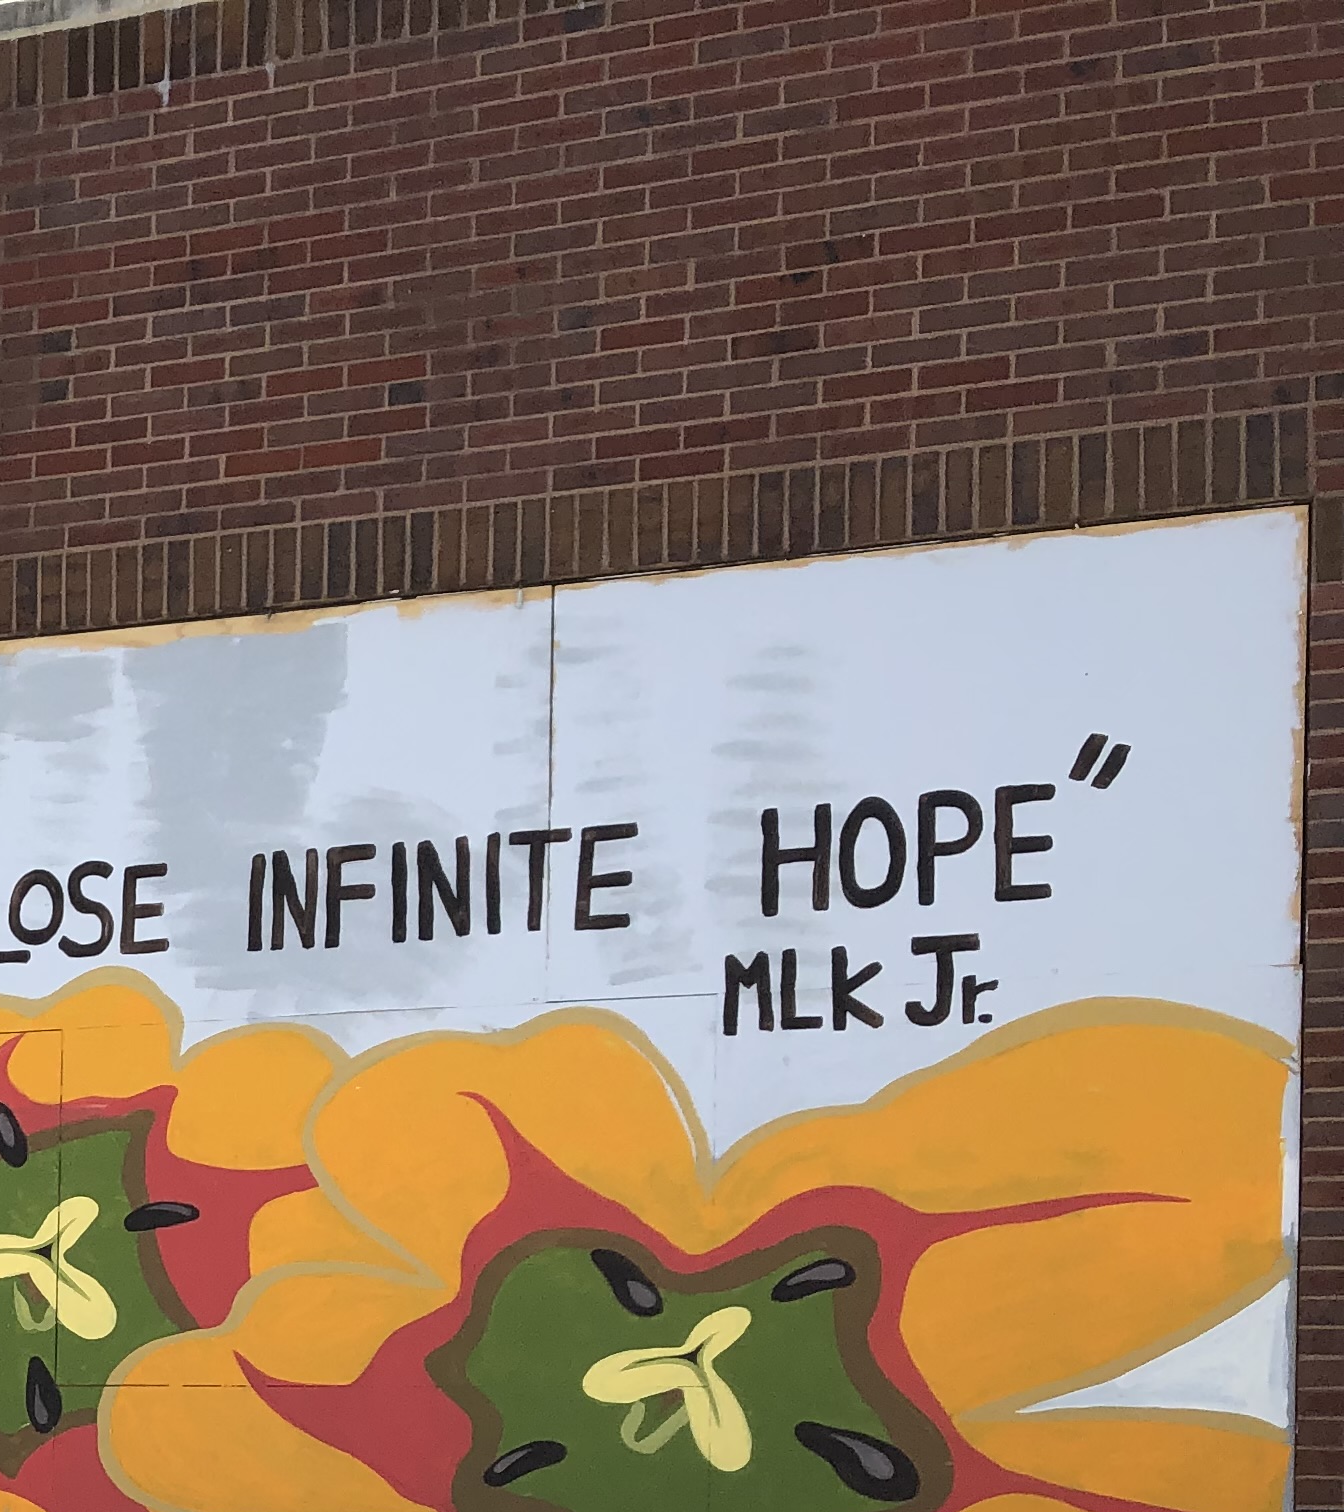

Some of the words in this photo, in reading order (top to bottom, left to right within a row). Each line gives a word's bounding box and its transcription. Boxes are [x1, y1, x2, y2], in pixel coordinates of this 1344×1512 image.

[246, 822, 638, 953] INFINITE
[760, 732, 1132, 918] HOPE"
[722, 945, 885, 1036] MLK
[904, 932, 1000, 1027] Jr.
